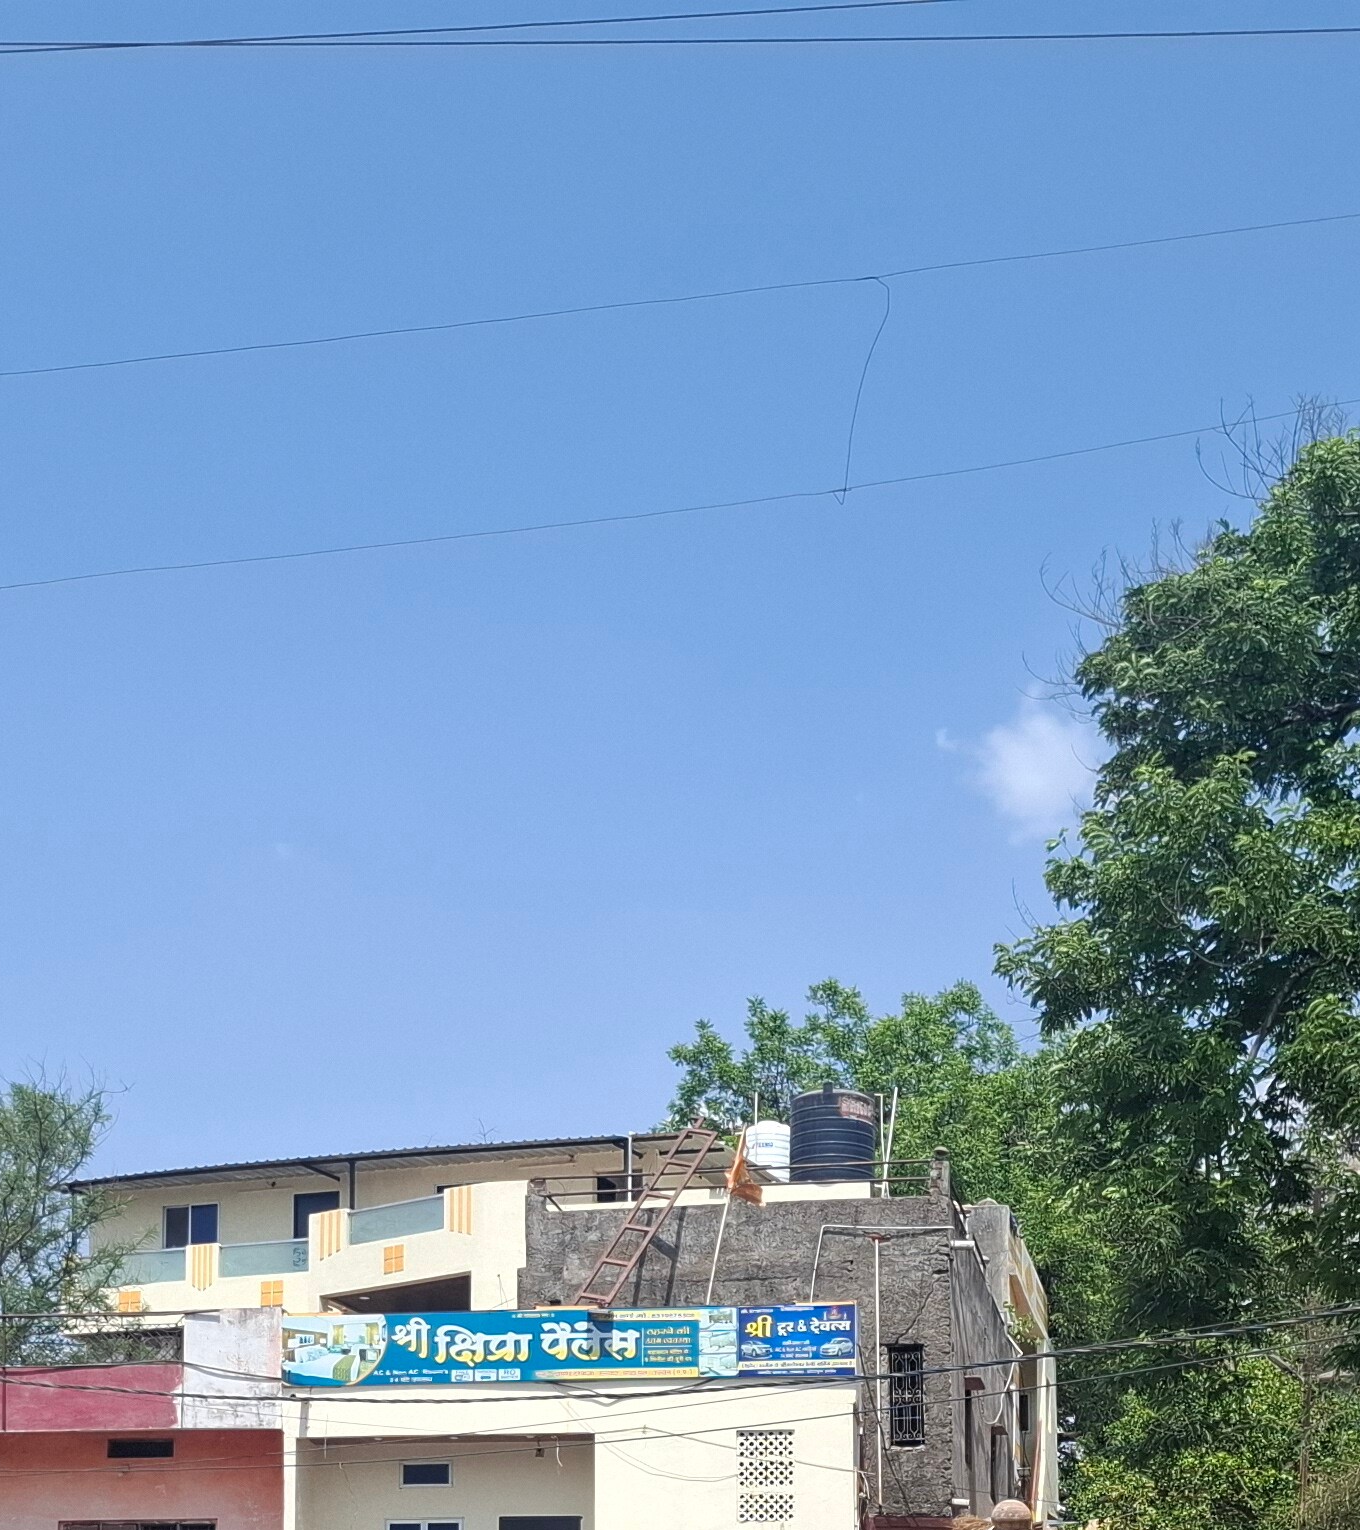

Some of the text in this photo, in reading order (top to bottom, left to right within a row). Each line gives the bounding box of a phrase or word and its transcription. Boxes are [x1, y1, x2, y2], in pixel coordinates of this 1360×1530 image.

[391, 1316, 431, 1358] श्री
[434, 1324, 533, 1368] क्षिप्रा
[745, 1314, 851, 1337] श्री टूर & ट्रेवल्स
